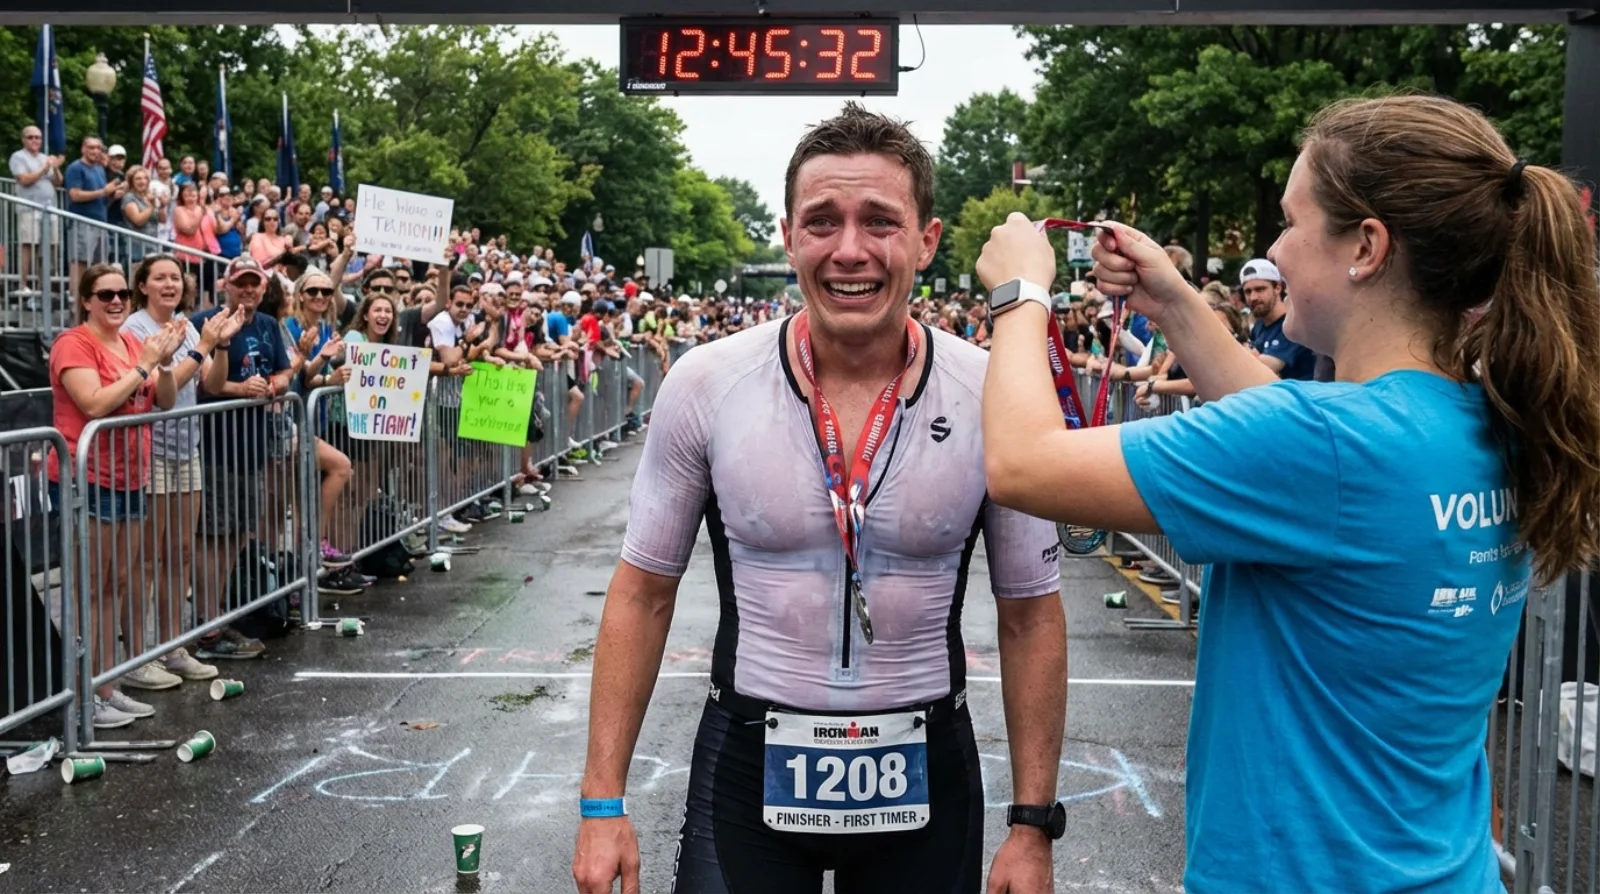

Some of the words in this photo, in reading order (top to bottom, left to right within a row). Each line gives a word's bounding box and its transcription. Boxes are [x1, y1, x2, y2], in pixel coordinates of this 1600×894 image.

[658, 28, 882, 79] 12:45:32
[369, 394, 387, 410] on
[786, 752, 908, 802] 1208
[776, 812, 831, 827] FINISHER
[843, 813, 877, 828] FIRST
[879, 810, 917, 825] TIMER
